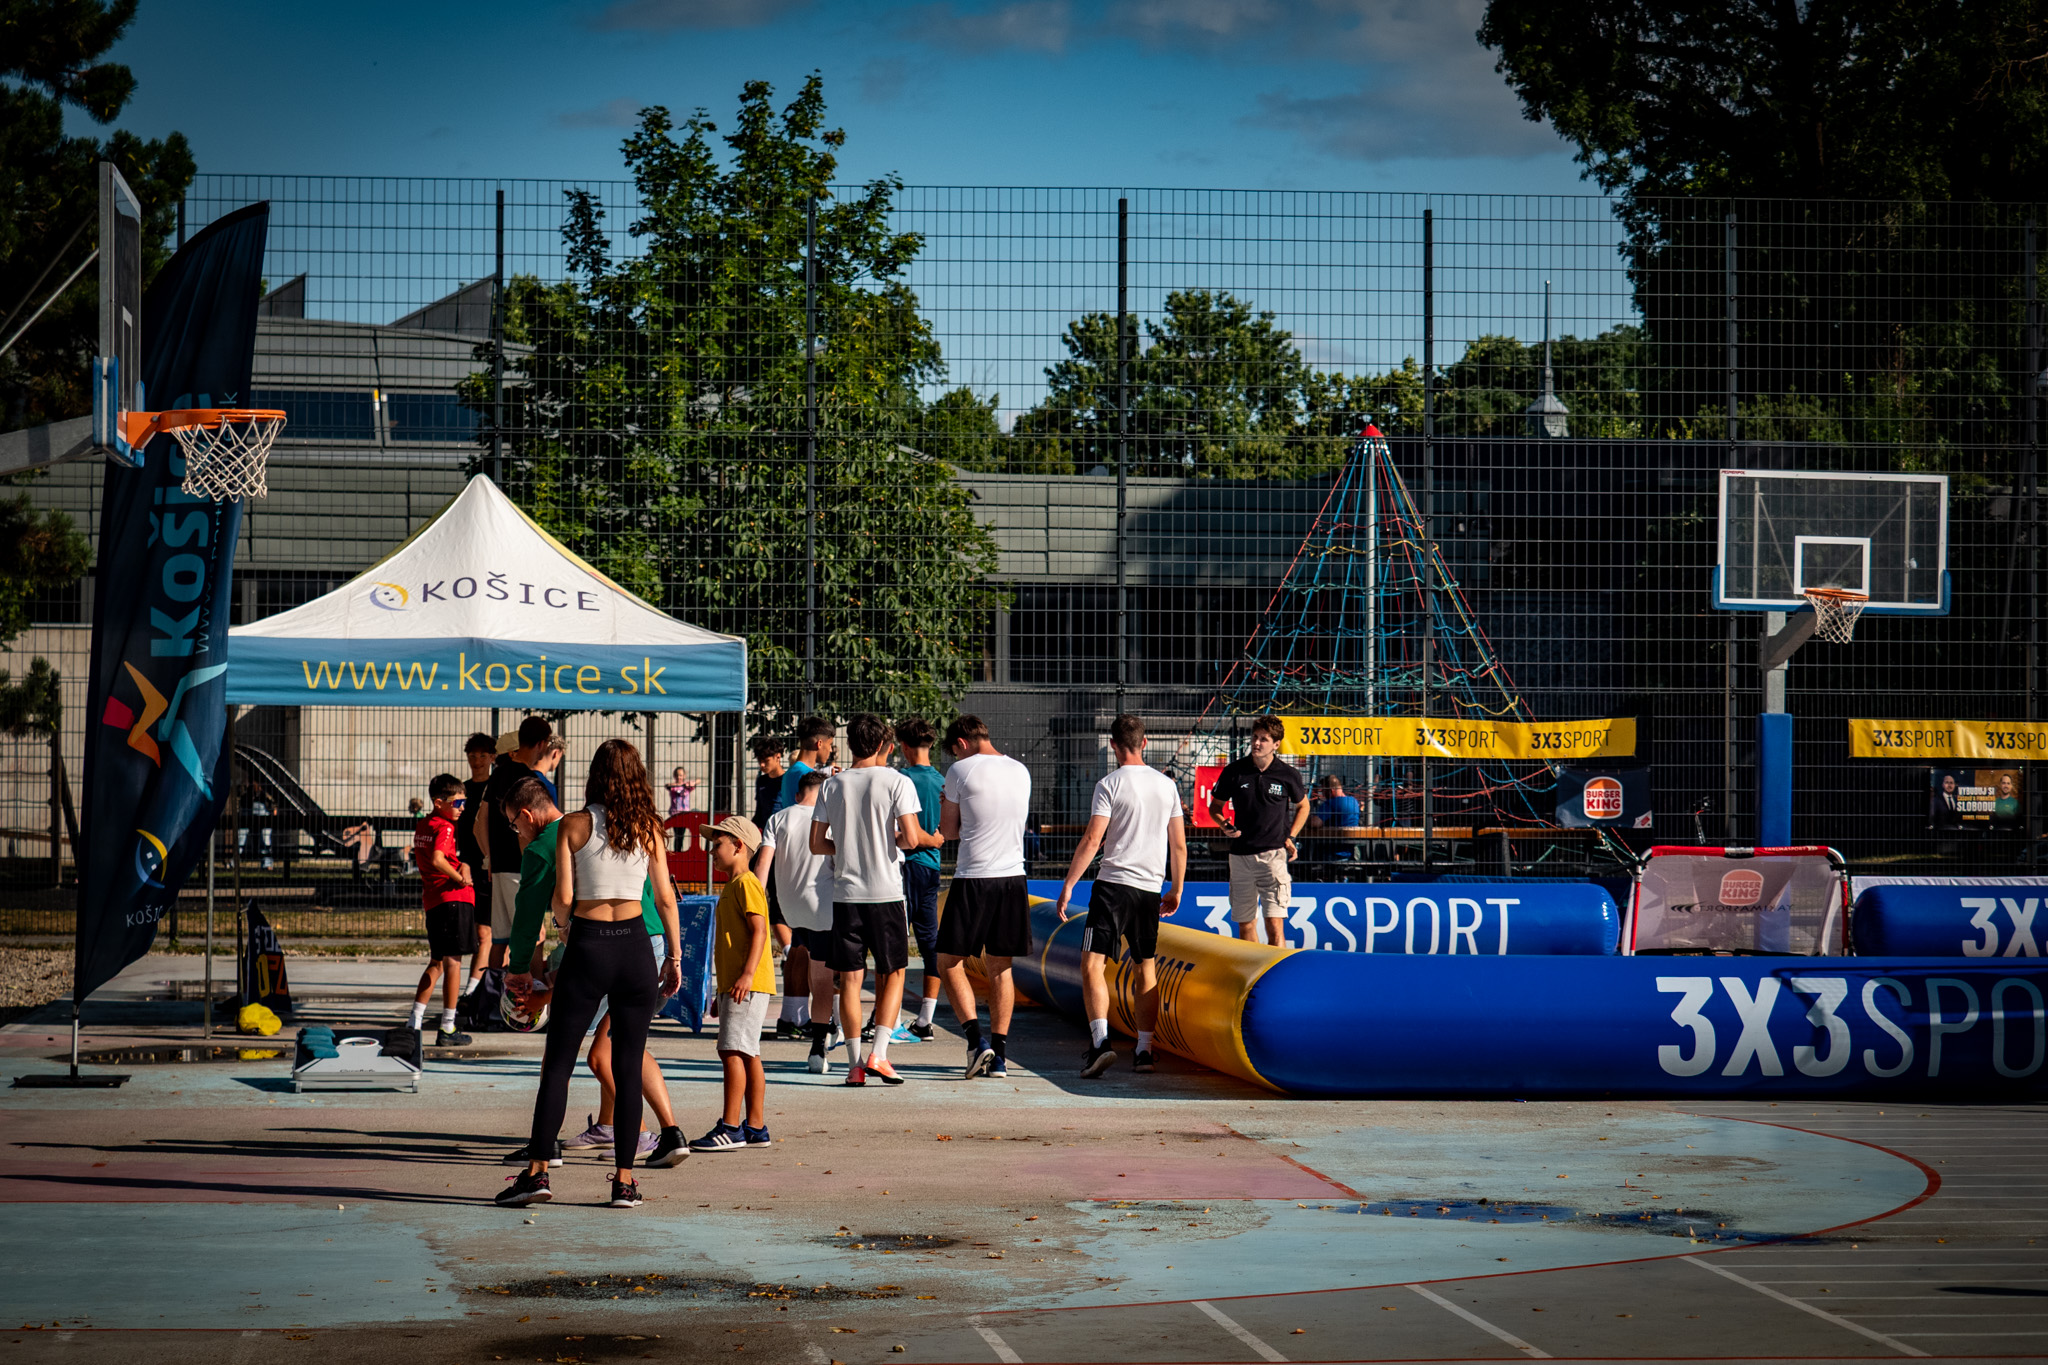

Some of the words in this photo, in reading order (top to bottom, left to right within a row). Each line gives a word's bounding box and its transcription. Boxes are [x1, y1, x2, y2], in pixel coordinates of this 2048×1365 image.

[422, 571, 600, 612] KOŠICE
[302, 653, 668, 695] www.kosice.sk
[1300, 727, 1382, 746] 3X3SPORT
[1416, 728, 1499, 748] 3X3SPORT
[1531, 729, 1612, 749] 3X3SPORT
[1873, 730, 1954, 748] 3X3SPORT
[1586, 790, 1620, 798] BURGER
[1587, 799, 1620, 810] KING
[1956, 801, 1996, 812] SLOBODU!
[1721, 889, 1760, 898] KING
[1723, 881, 1761, 889] BURGER
[1196, 896, 1521, 955] 33SPORT
[1960, 897, 2048, 958] 3X
